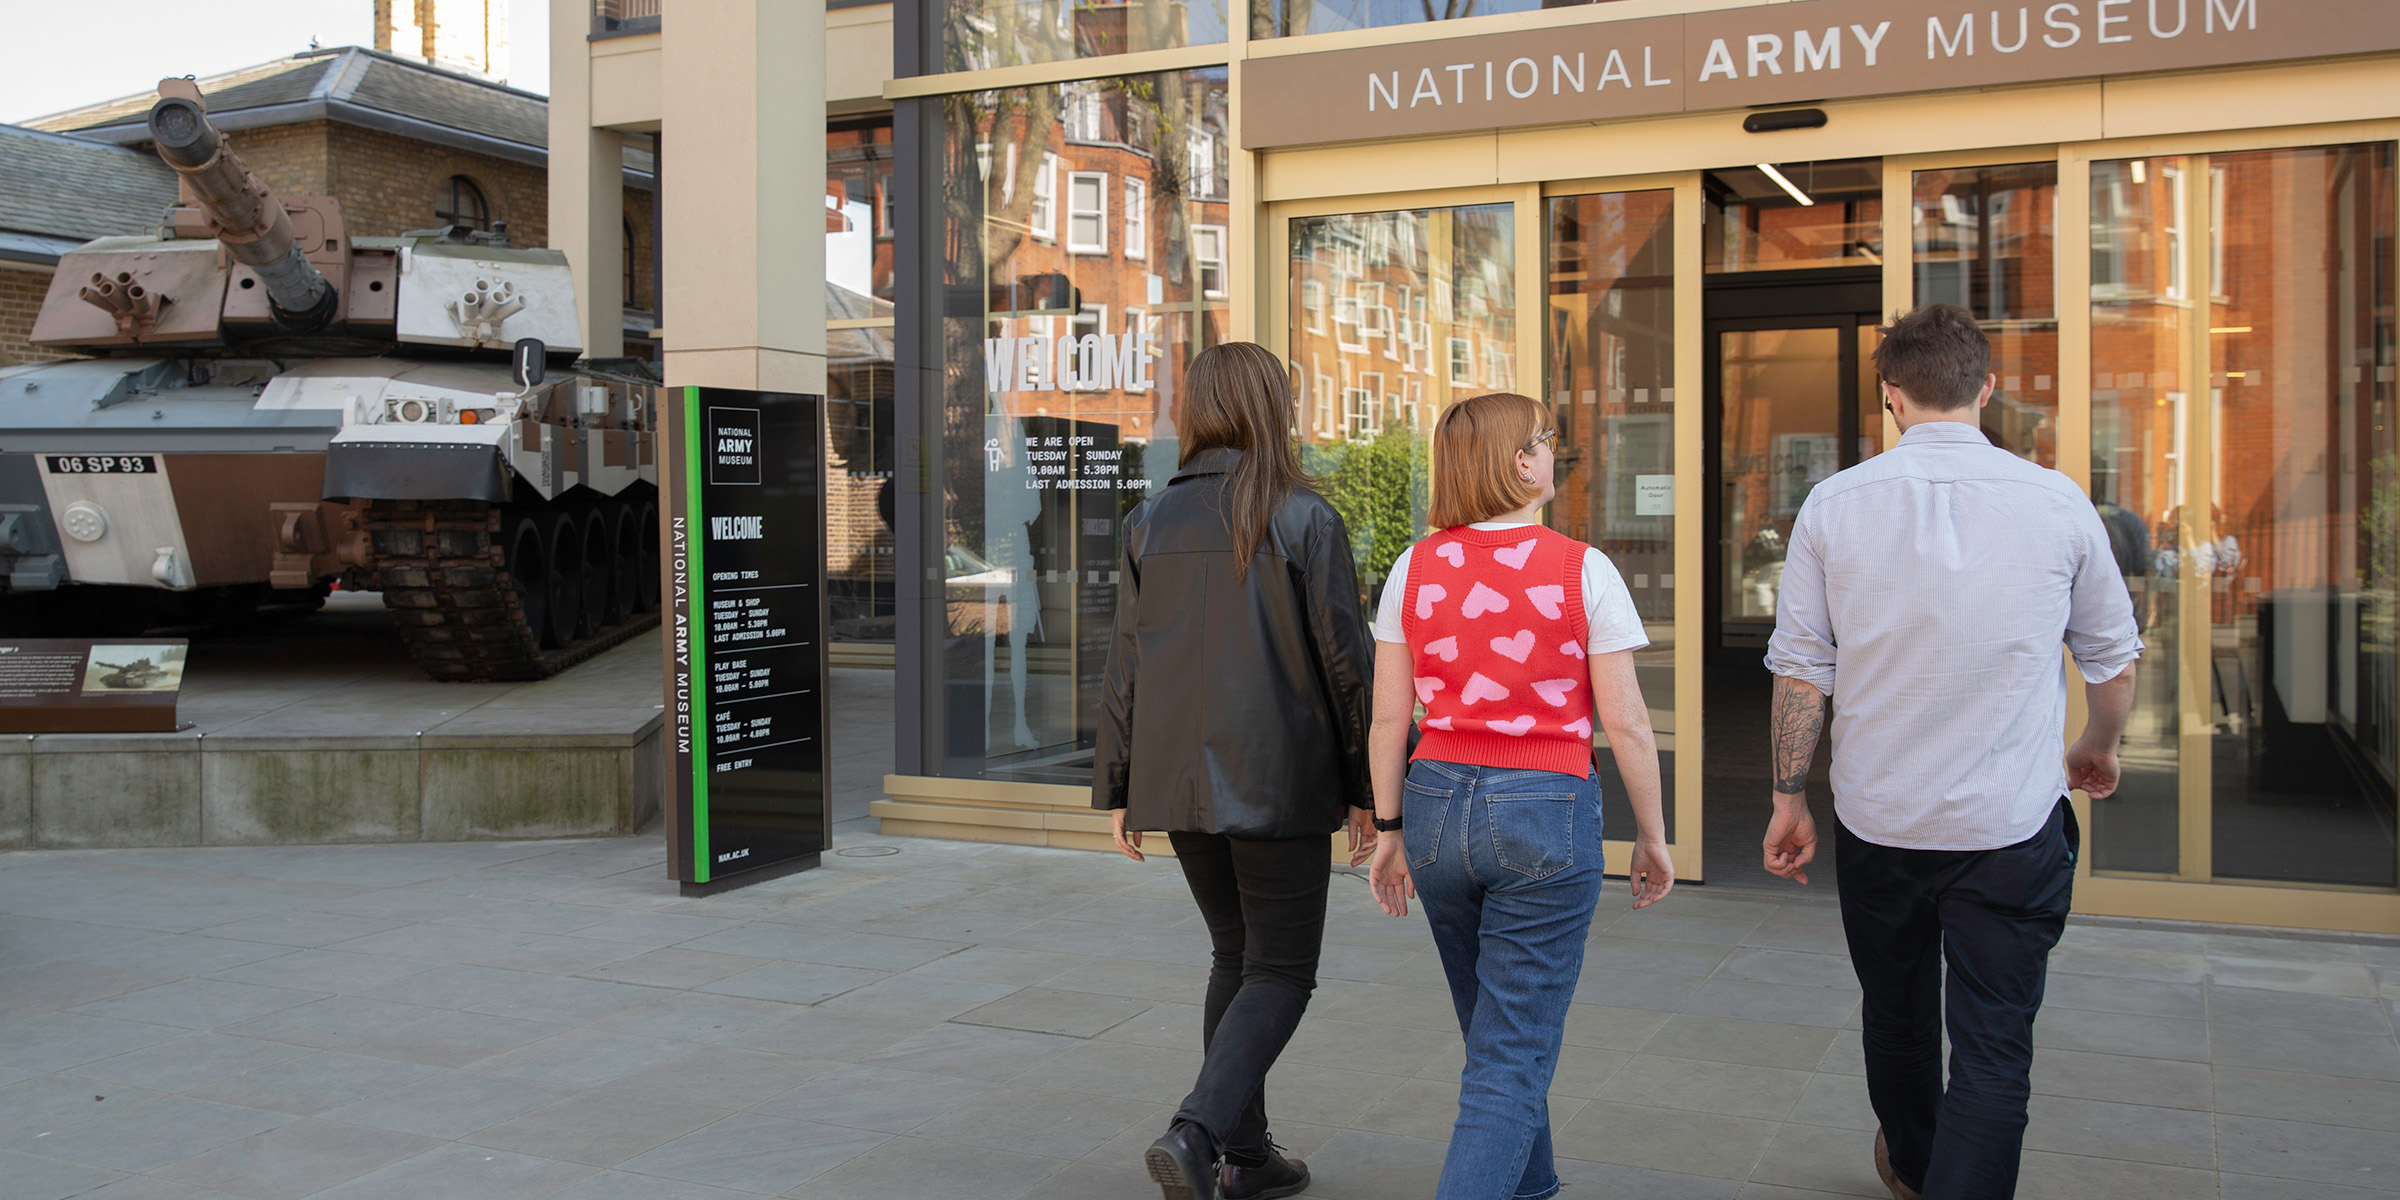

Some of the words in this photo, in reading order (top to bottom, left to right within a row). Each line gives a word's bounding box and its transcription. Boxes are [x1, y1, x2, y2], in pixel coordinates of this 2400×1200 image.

[1368, 46, 1672, 112] NATIONAL
[1698, 21, 1891, 82] ARMY
[1926, 0, 2257, 60] MUSEUM
[984, 332, 1155, 393] WELCOME
[717, 427, 752, 437] NATIONAL
[717, 438, 753, 453] ARMY
[1026, 437, 1038, 446] WE
[1044, 437, 1062, 446] ARE
[1069, 436, 1094, 446] OPEN
[718, 455, 753, 465] MUSEUM
[1026, 451, 1067, 461] TUESDAY
[1086, 450, 1123, 460] SUNDAY
[58, 457, 84, 473] 06
[87, 457, 115, 473] SP
[120, 457, 145, 472] 93
[1026, 466, 1065, 475] 10.00AM
[1083, 465, 1119, 475] 5.30PM
[1026, 480, 1050, 489] LAST
[1056, 479, 1110, 489] ADMISSION
[1116, 479, 1152, 489] 5.00PM
[711, 516, 763, 540] WELCOME
[673, 517, 687, 607] NATIONAL
[712, 571, 738, 581] OPENING
[740, 570, 759, 579] TIMES
[713, 600, 736, 609] MUSEUM
[738, 599, 743, 607] &
[745, 598, 761, 607] SHOP
[713, 611, 739, 620] TUESDAY
[748, 608, 770, 618] SUNDAY
[747, 619, 768, 629] 5.30PM
[676, 614, 688, 666] ARMY
[714, 634, 729, 643] LAST
[732, 630, 764, 641] ADMISSION
[714, 662, 730, 671] PLAY
[732, 660, 747, 669] BASE
[714, 672, 741, 682] TUESDAY
[749, 668, 771, 678] SUNDAY
[677, 673, 690, 753] MUSEUM
[715, 711, 731, 722] CAFÉ
[715, 722, 741, 733] TUESDAY
[750, 717, 772, 727] SUNDAY
[716, 763, 732, 772] FREE
[734, 759, 753, 770] ENTRY
[718, 848, 749, 863] NAM.AC.UK
